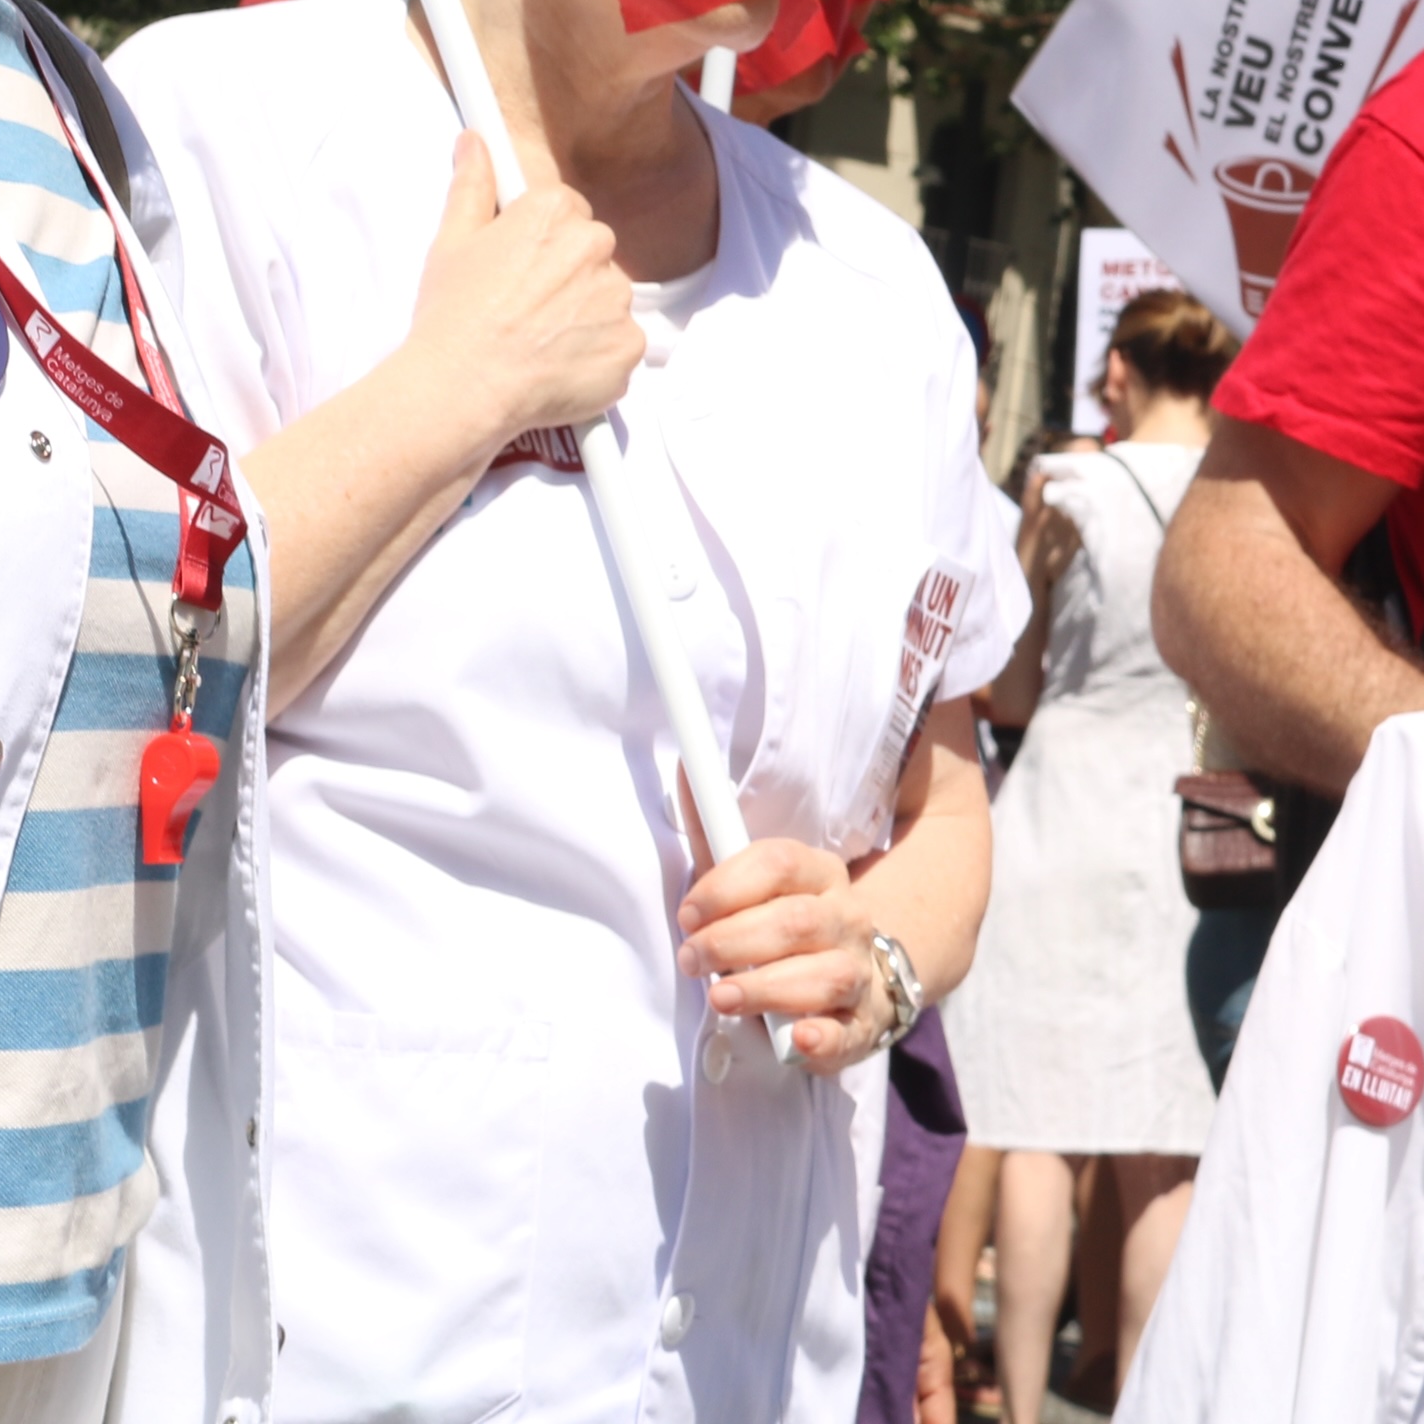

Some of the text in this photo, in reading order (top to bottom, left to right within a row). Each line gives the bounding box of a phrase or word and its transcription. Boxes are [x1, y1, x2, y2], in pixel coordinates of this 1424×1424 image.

[1199, 86, 1222, 122] LA
[1223, 34, 1275, 128] VEU
[1263, 111, 1287, 145] EL
[45, 357, 114, 424] Catalunya
[54, 345, 105, 395] Metges
[104, 388, 124, 410] de
[926, 570, 960, 620] UN
[1340, 1063, 1364, 1092] EN
